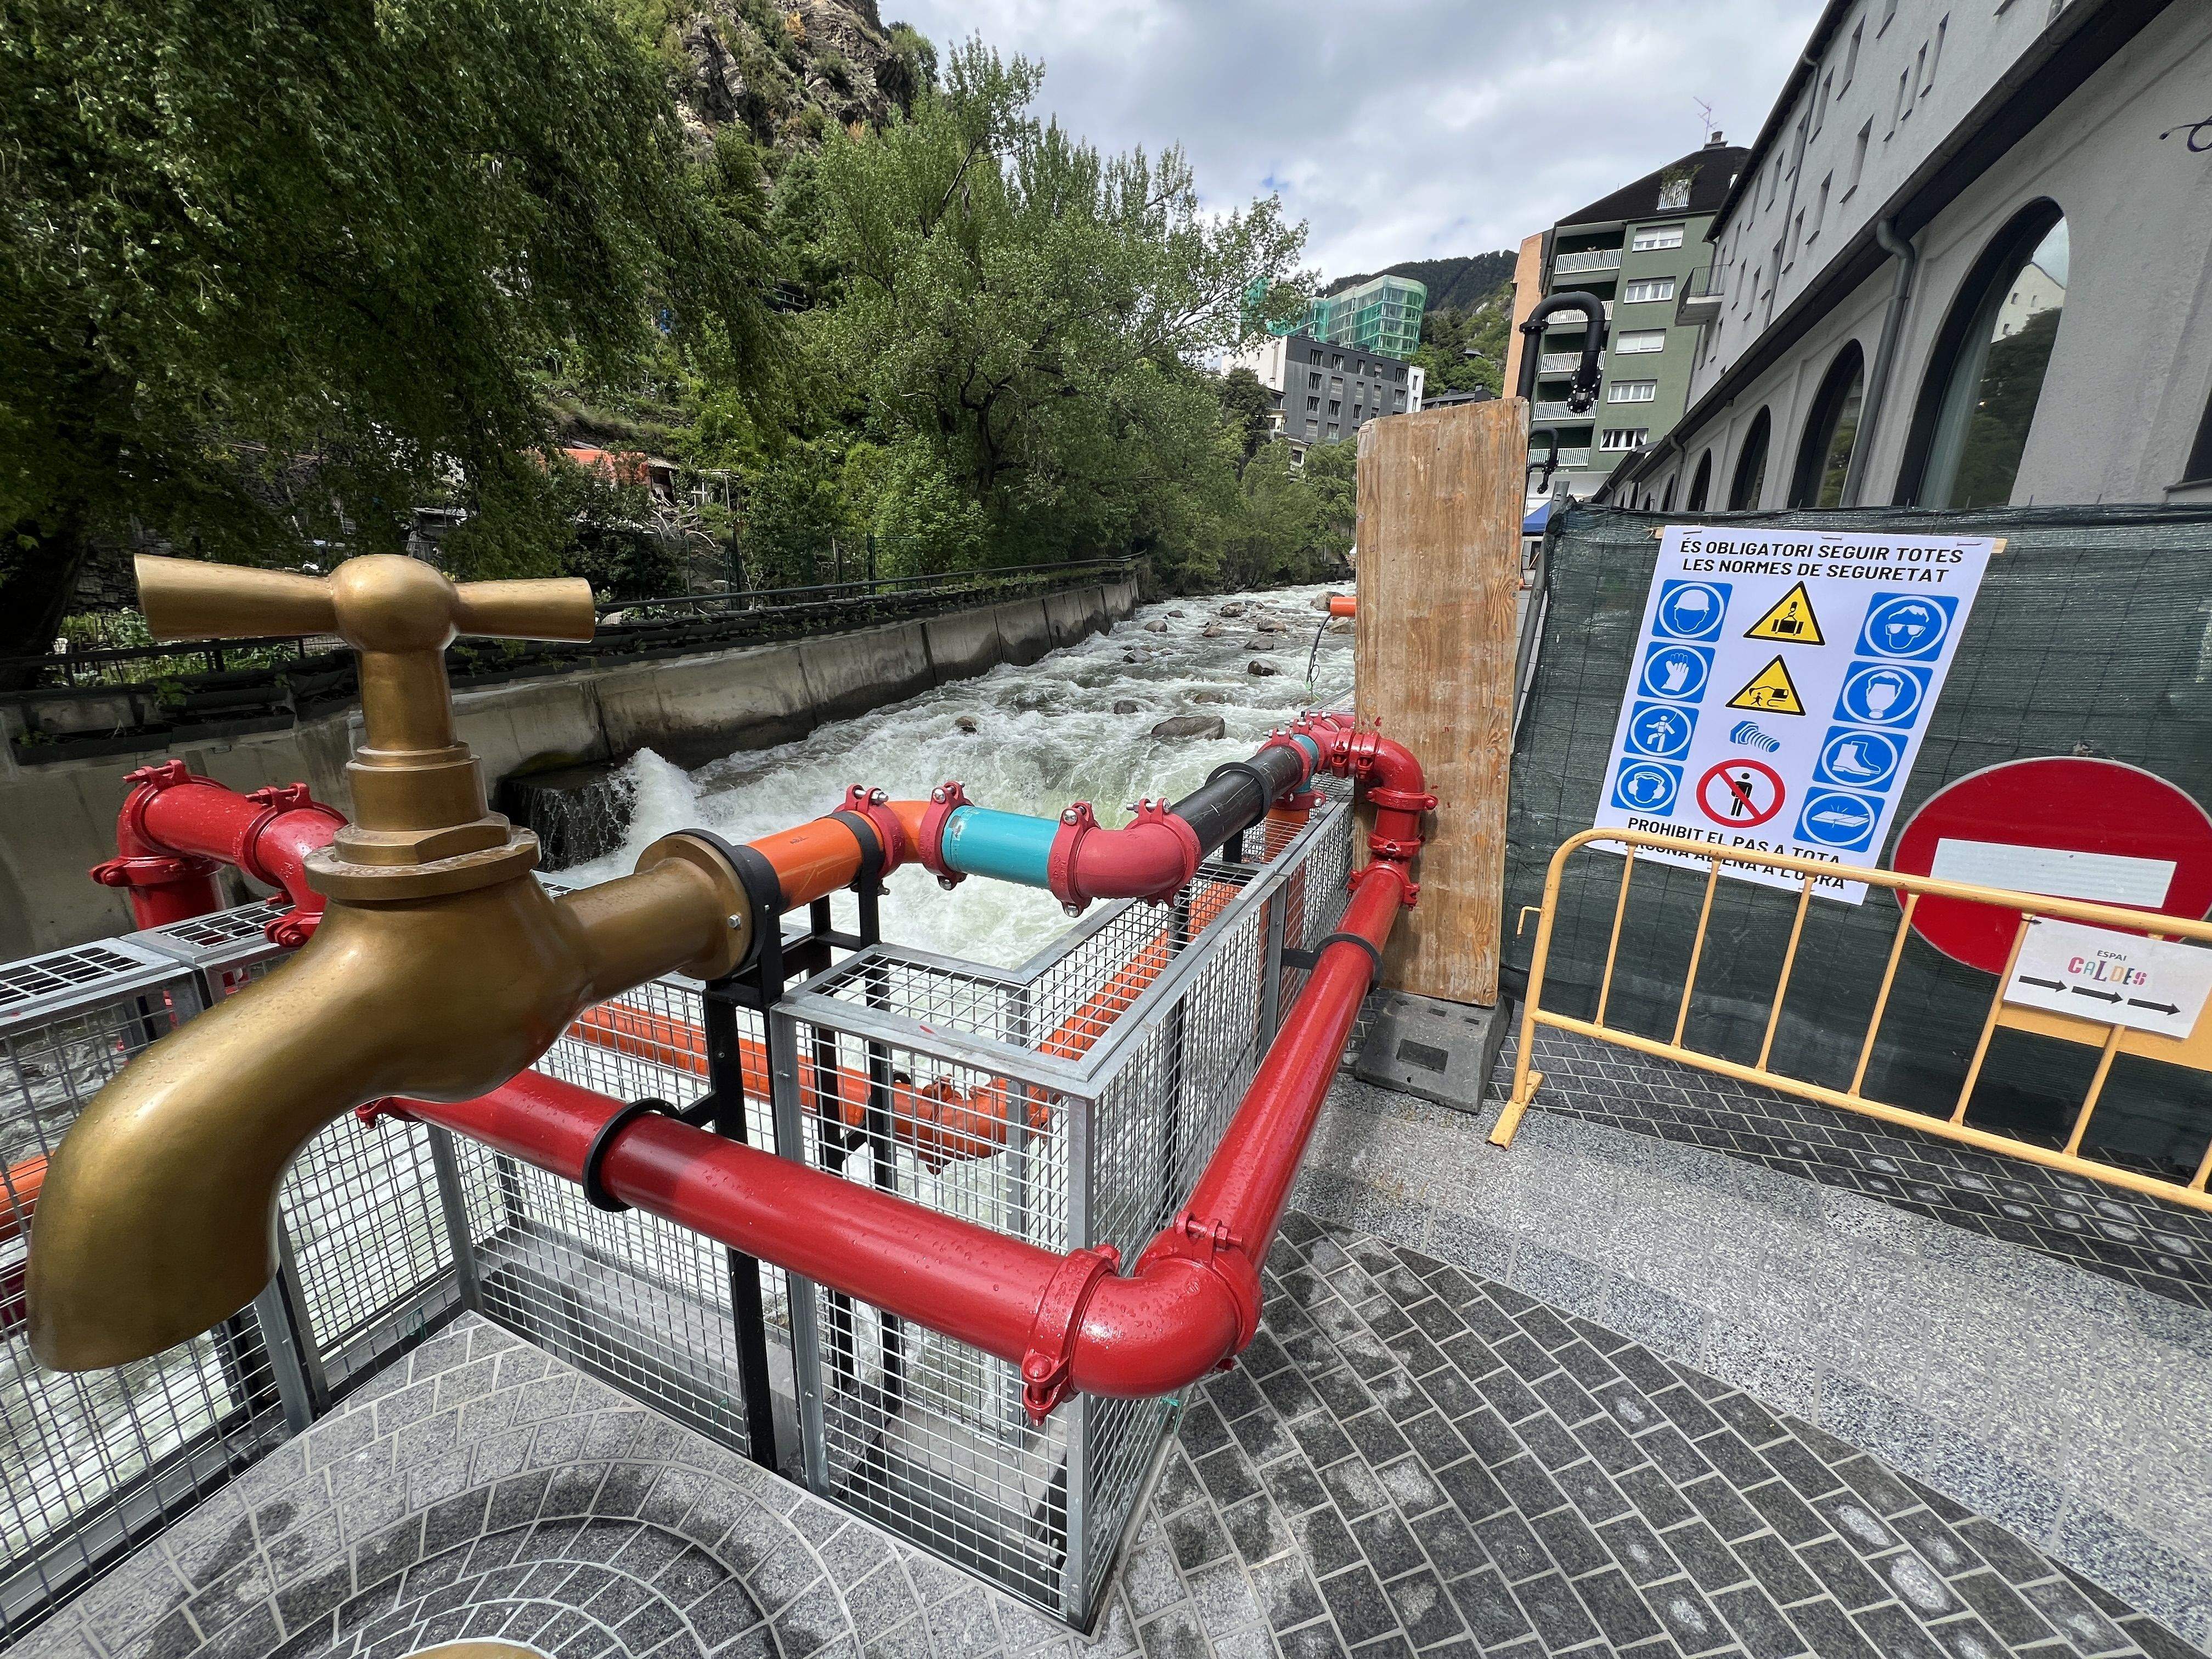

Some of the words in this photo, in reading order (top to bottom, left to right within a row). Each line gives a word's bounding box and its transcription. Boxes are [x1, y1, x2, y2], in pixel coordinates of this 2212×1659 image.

[1680, 538, 1701, 552] ÉS
[1706, 541, 1813, 557] OBLIGATORI
[1818, 545, 1889, 560] SEGUIR
[1897, 548, 1963, 563] TOTES
[1683, 558, 1714, 571] LES
[1719, 560, 1793, 575] NORMES
[1797, 563, 1822, 576] DE
[1826, 565, 1949, 582] SEGURETAT
[1628, 817, 1703, 840] PROHIBIT
[1707, 832, 1727, 845] EL
[1733, 836, 1769, 851] PAS
[1774, 844, 1784, 854] A
[1792, 847, 1839, 863] TOTA
[2097, 950, 2127, 961] ESPAI
[2068, 957, 2147, 985] CALDES
